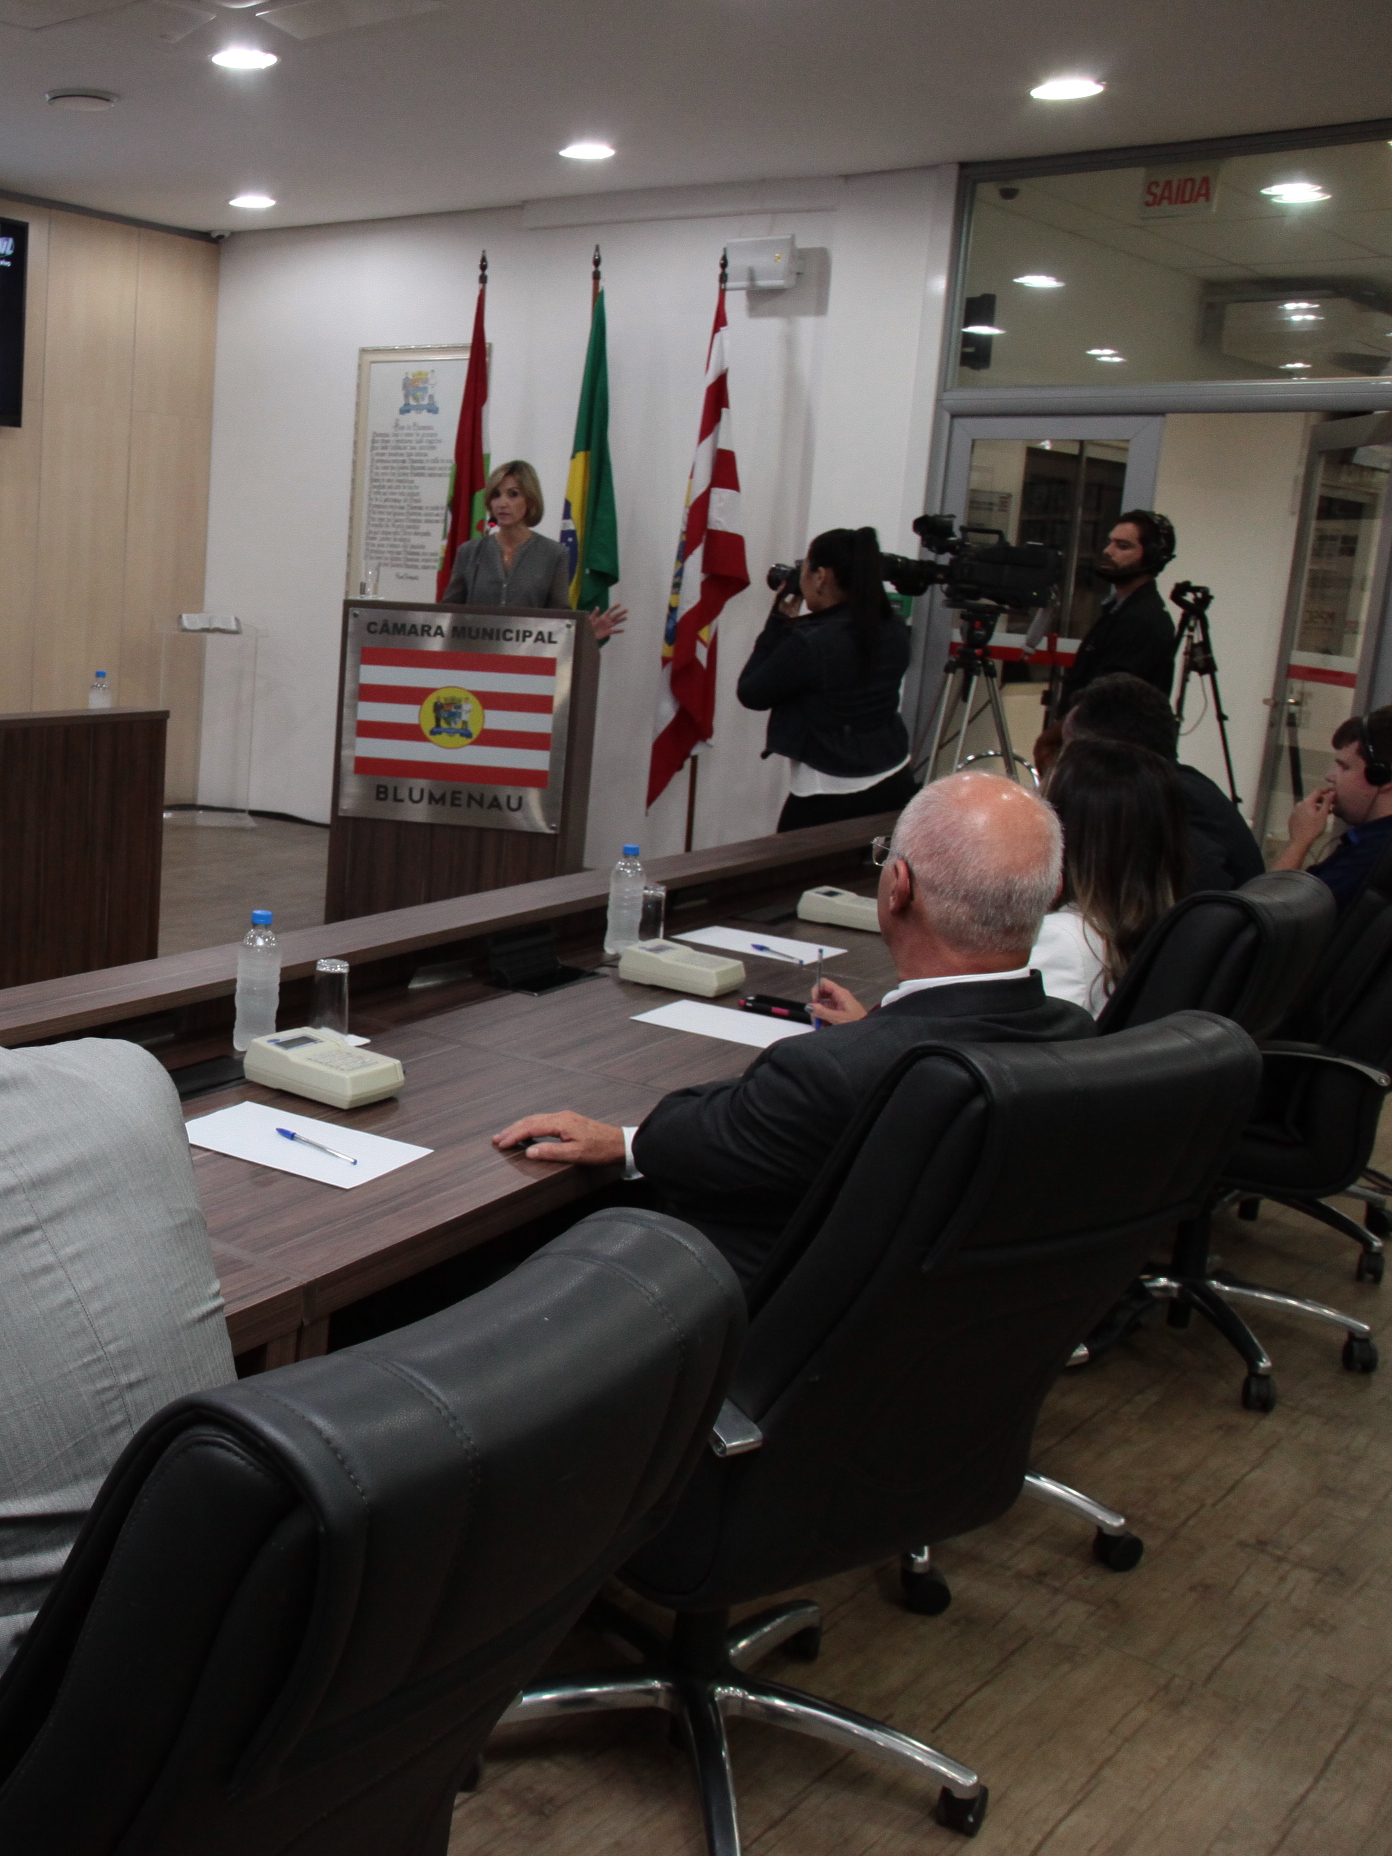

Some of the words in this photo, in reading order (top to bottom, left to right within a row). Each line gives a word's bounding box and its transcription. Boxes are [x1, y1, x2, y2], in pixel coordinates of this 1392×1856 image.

[366, 619, 445, 638] CÂMARA
[451, 625, 558, 644] MUNICIPAL
[375, 784, 523, 812] BLUMENAU
